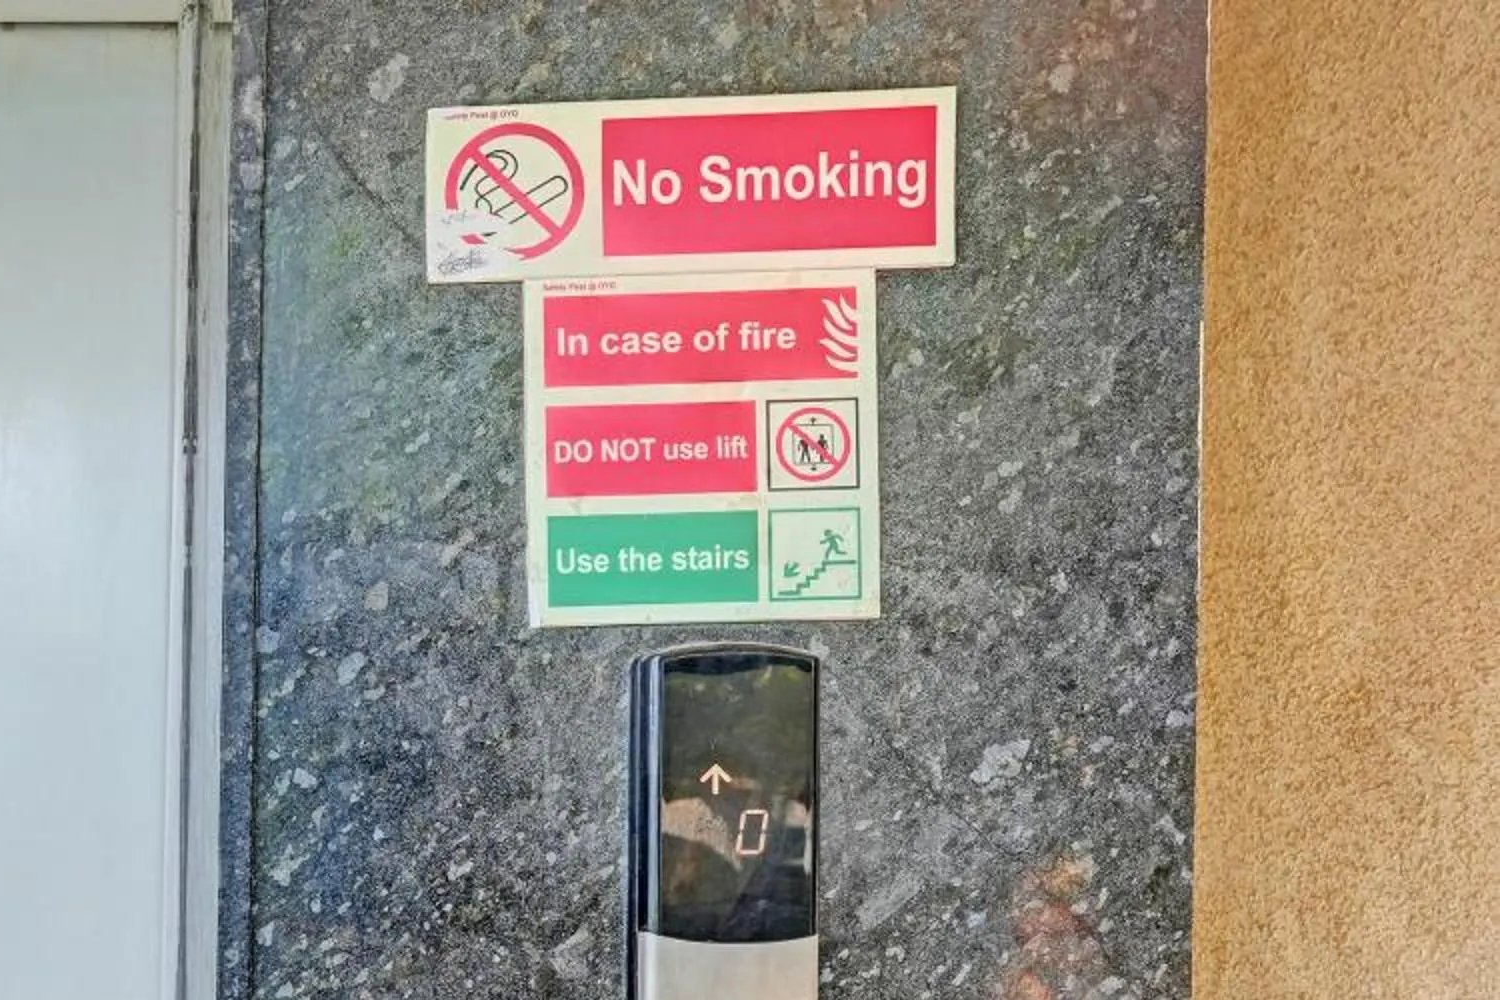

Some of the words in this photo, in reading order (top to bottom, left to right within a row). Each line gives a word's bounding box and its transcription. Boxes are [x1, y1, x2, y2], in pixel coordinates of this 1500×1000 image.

[612, 158, 682, 206] No
[699, 150, 927, 208] Smoking
[556, 327, 589, 356] In
[600, 330, 682, 355] case
[693, 322, 729, 352] of
[738, 321, 797, 350] fire
[554, 439, 593, 464] DO
[600, 437, 656, 462] NOT
[663, 442, 709, 461] use
[716, 435, 748, 459] lift
[556, 548, 609, 575] Use
[619, 546, 662, 573] the
[672, 544, 750, 572] stairs
[736, 809, 769, 855] 0
